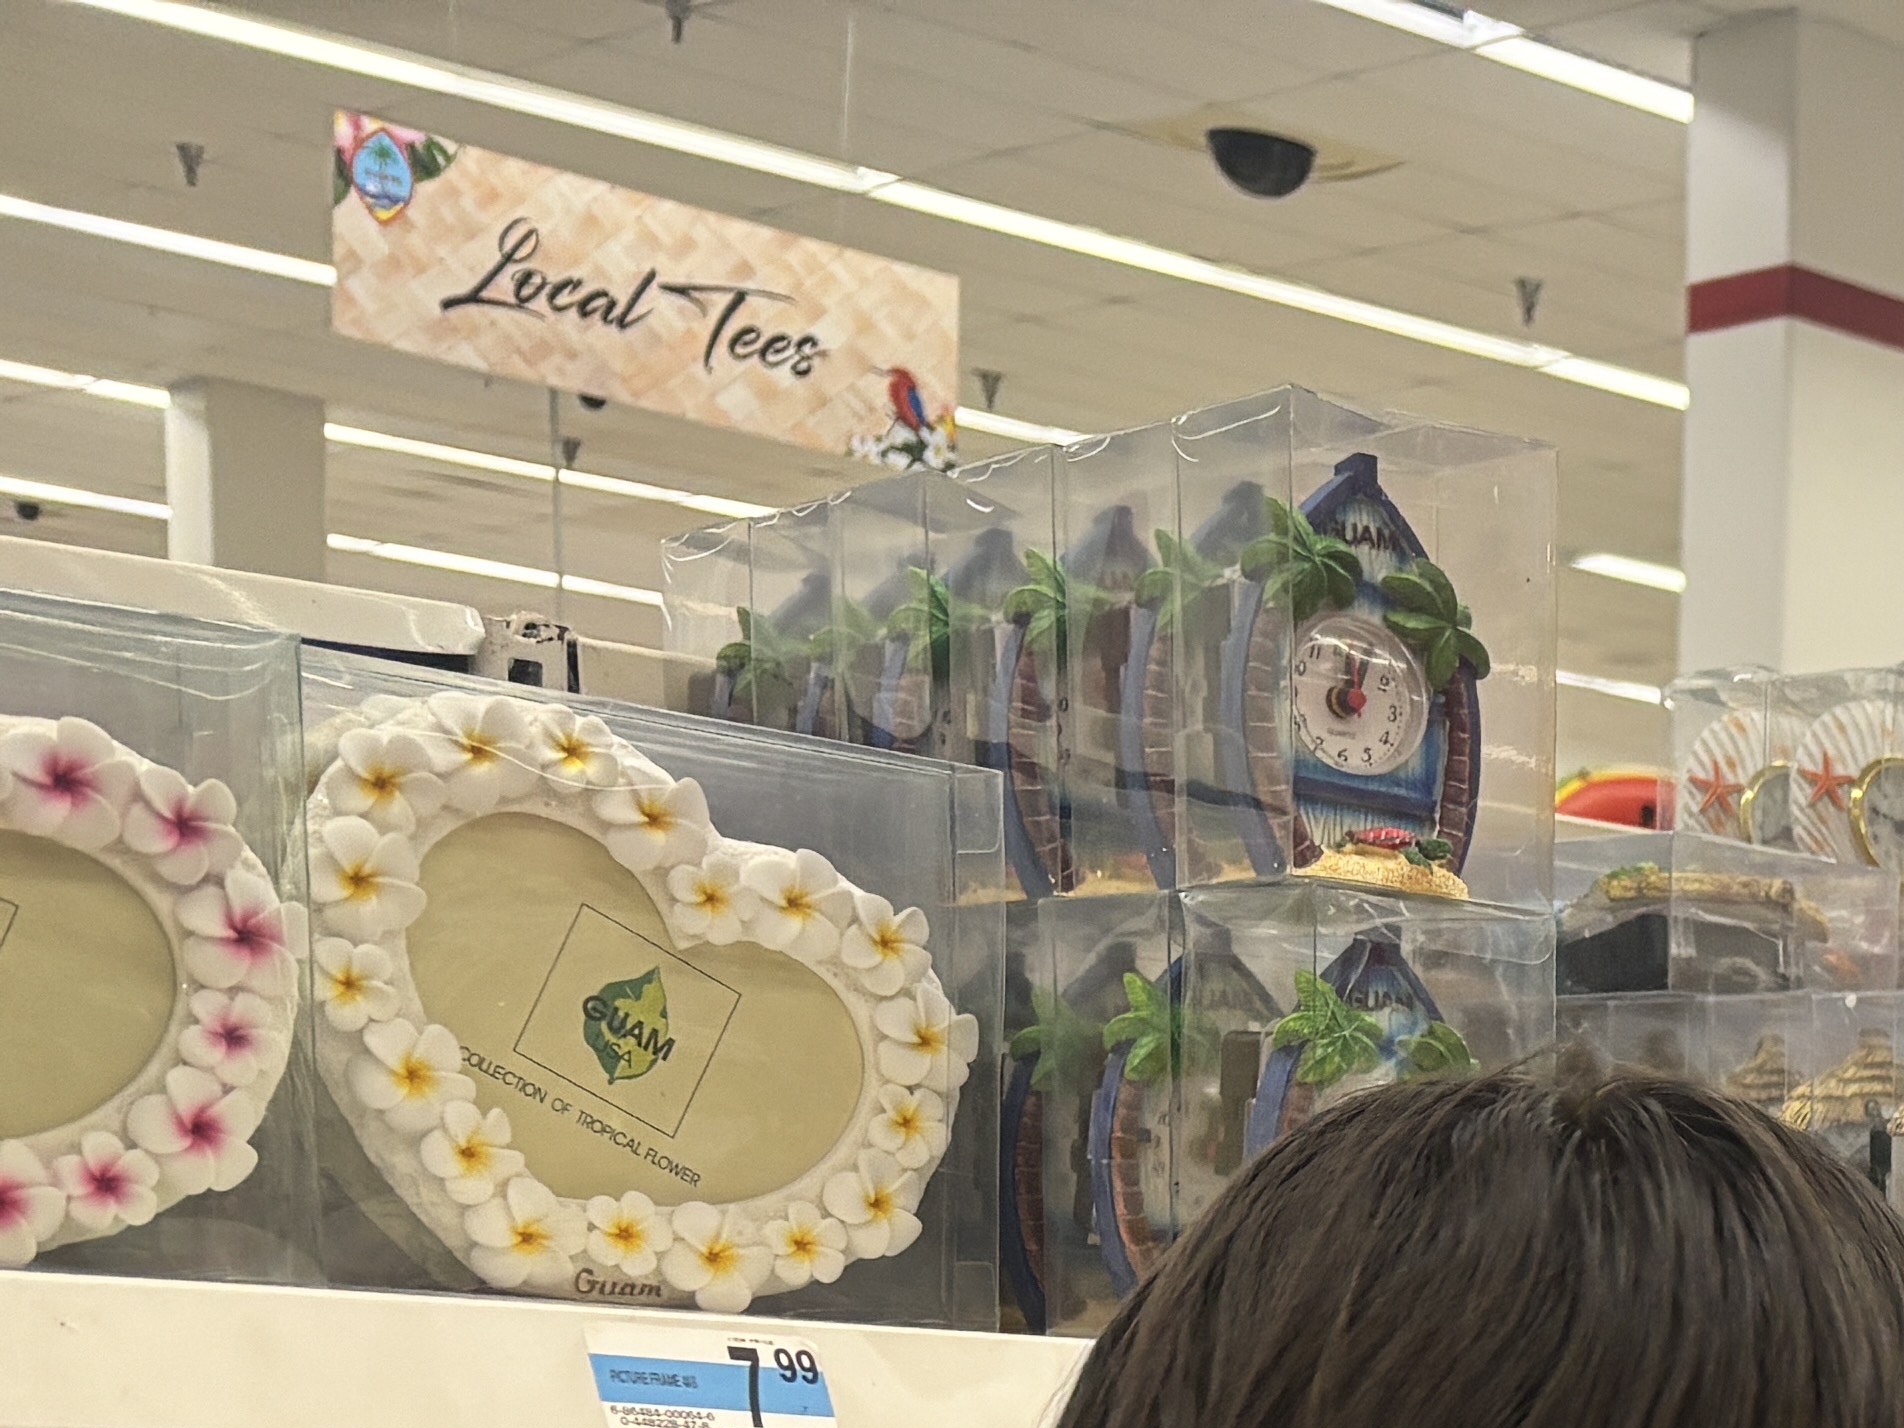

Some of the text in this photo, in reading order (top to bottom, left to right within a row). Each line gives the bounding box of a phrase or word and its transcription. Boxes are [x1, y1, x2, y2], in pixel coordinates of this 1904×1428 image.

[439, 216, 830, 376] Local Tees
[583, 994, 676, 1062] GUAM
[598, 1037, 634, 1069] USA
[460, 1045, 702, 1188] COLLECTION OF TROPICAL FLOWER
[574, 1267, 664, 1299] Guam
[726, 1345, 820, 1428] 7 99
